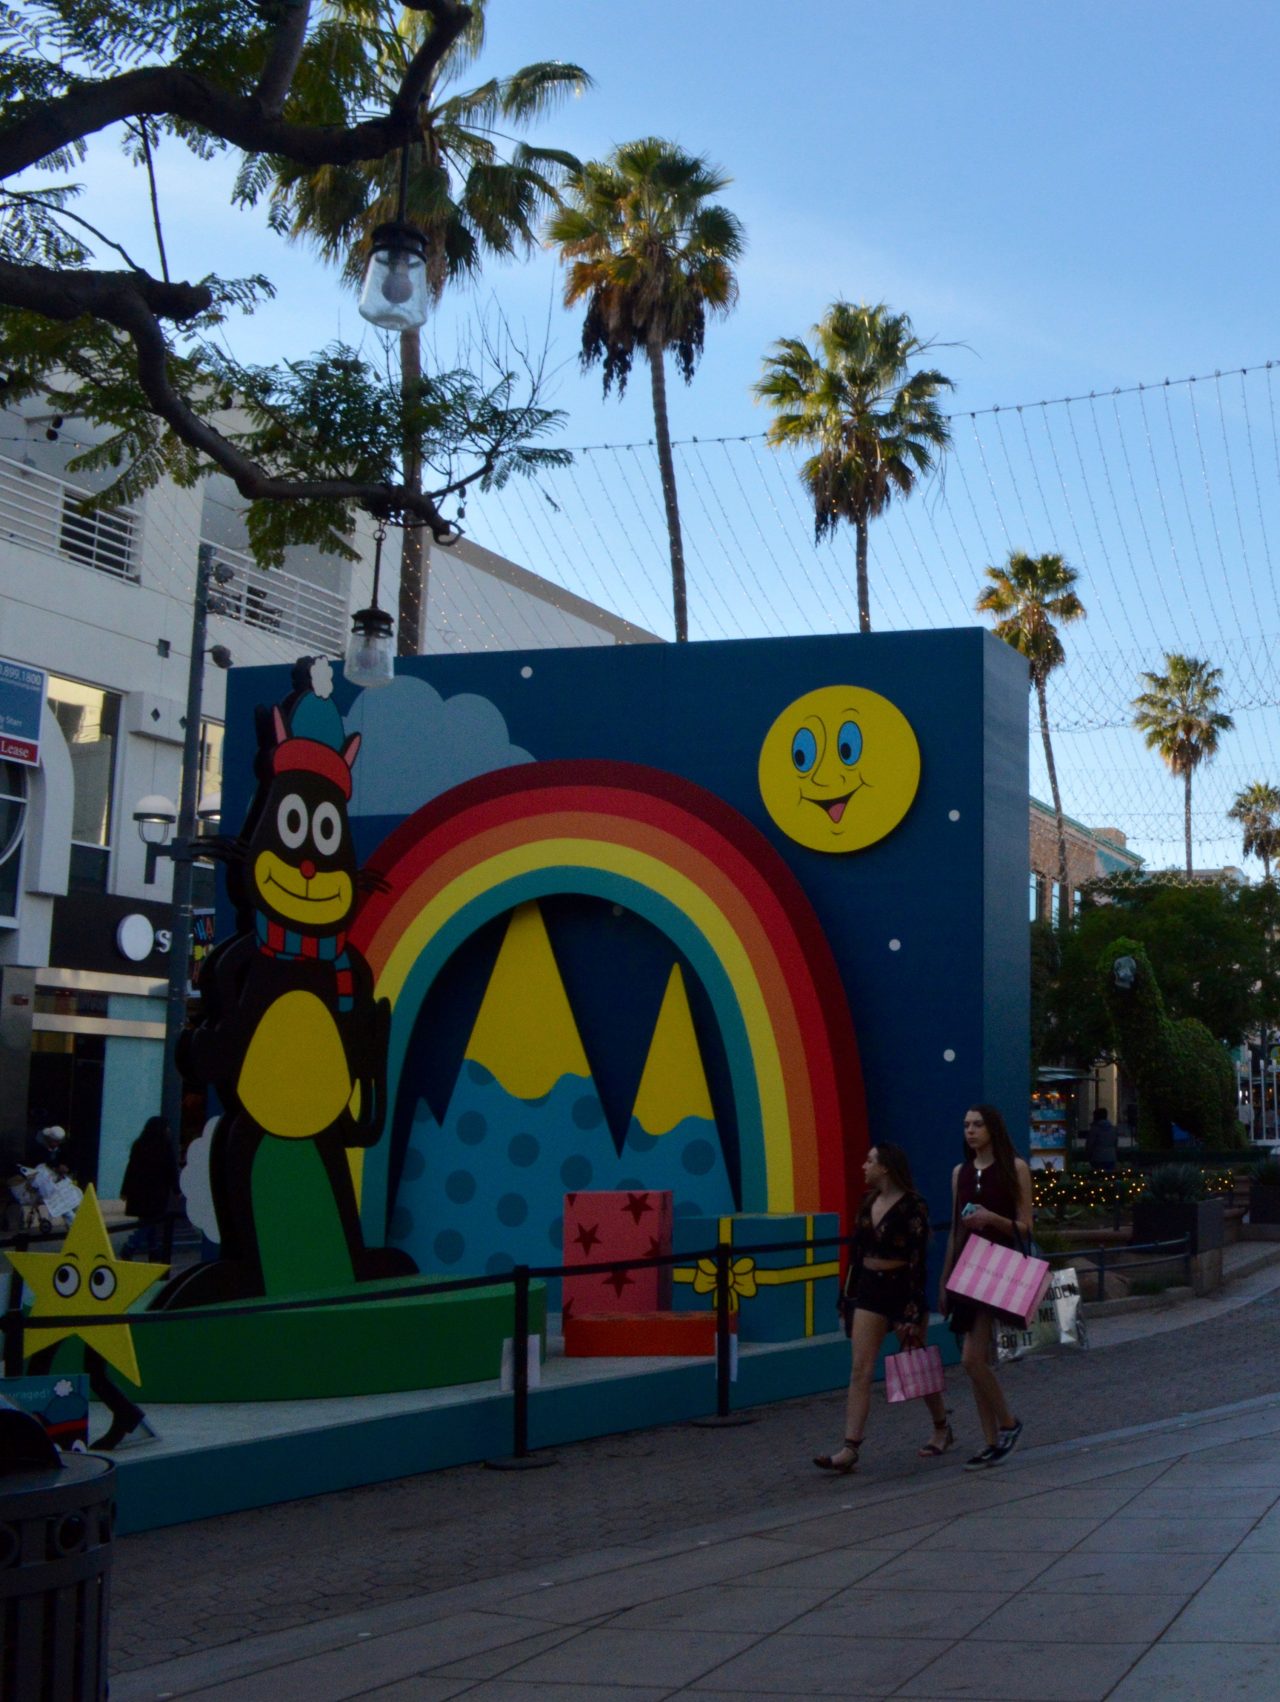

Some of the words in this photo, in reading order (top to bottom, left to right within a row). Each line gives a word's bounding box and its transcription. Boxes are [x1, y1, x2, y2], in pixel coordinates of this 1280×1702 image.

[1, 740, 30, 758] Lease
[1043, 1283, 1080, 1301] DDEN
[1039, 1307, 1056, 1322] ME
[1022, 1331, 1032, 1347] IT
